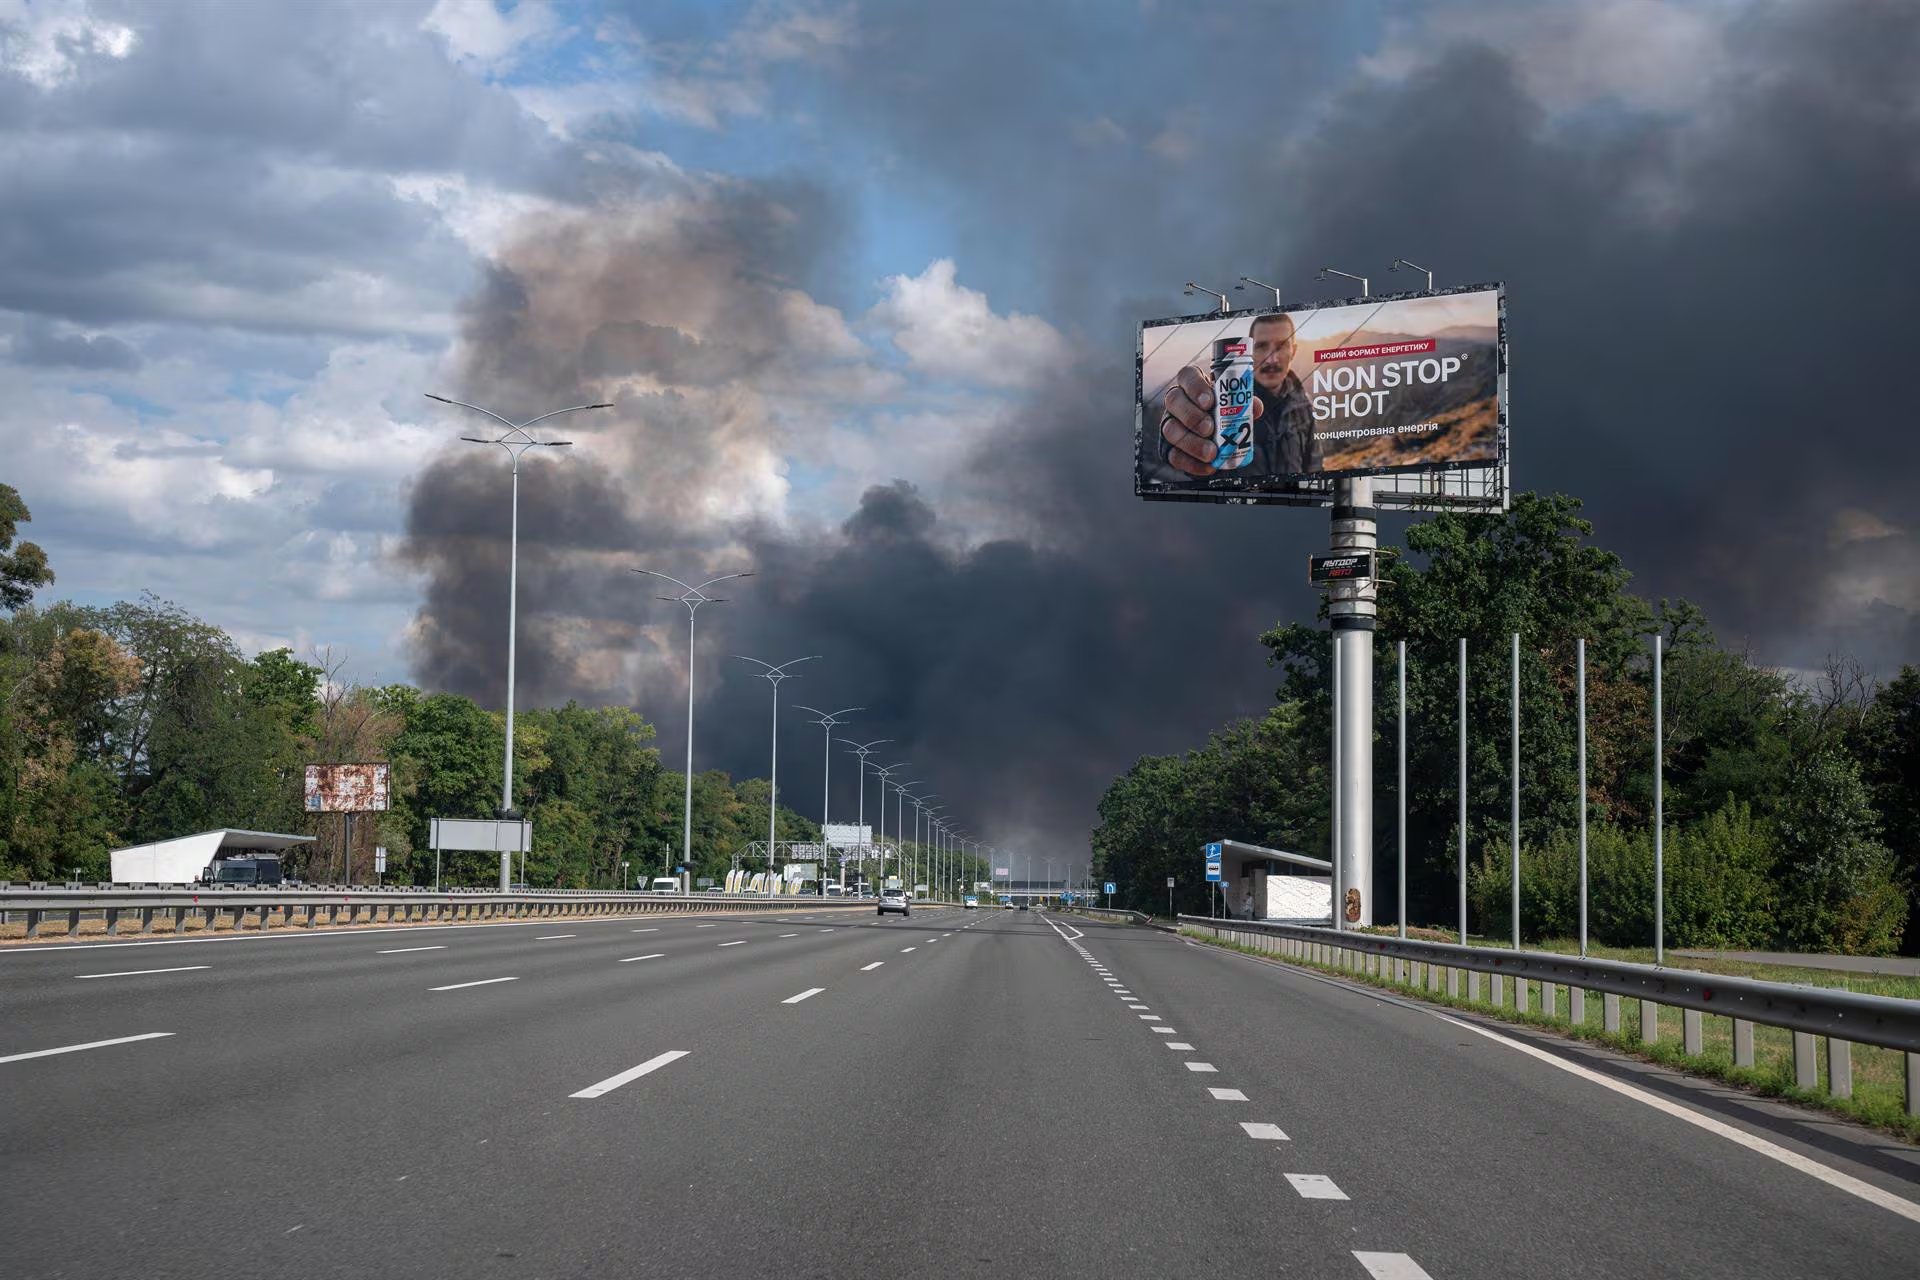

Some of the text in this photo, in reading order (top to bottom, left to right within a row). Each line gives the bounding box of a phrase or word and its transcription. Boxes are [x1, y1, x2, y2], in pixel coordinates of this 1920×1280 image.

[1320, 342, 1430, 360] НОВИЙ ФОРМАТ ЕНЕРГЕТИКУ
[1219, 378, 1248, 392] NON
[1313, 364, 1376, 394] NON
[1219, 391, 1252, 406] STOP
[1312, 390, 1390, 420] SHOT
[1220, 407, 1238, 416] SHOT
[1313, 421, 1438, 440] концентрована енергія
